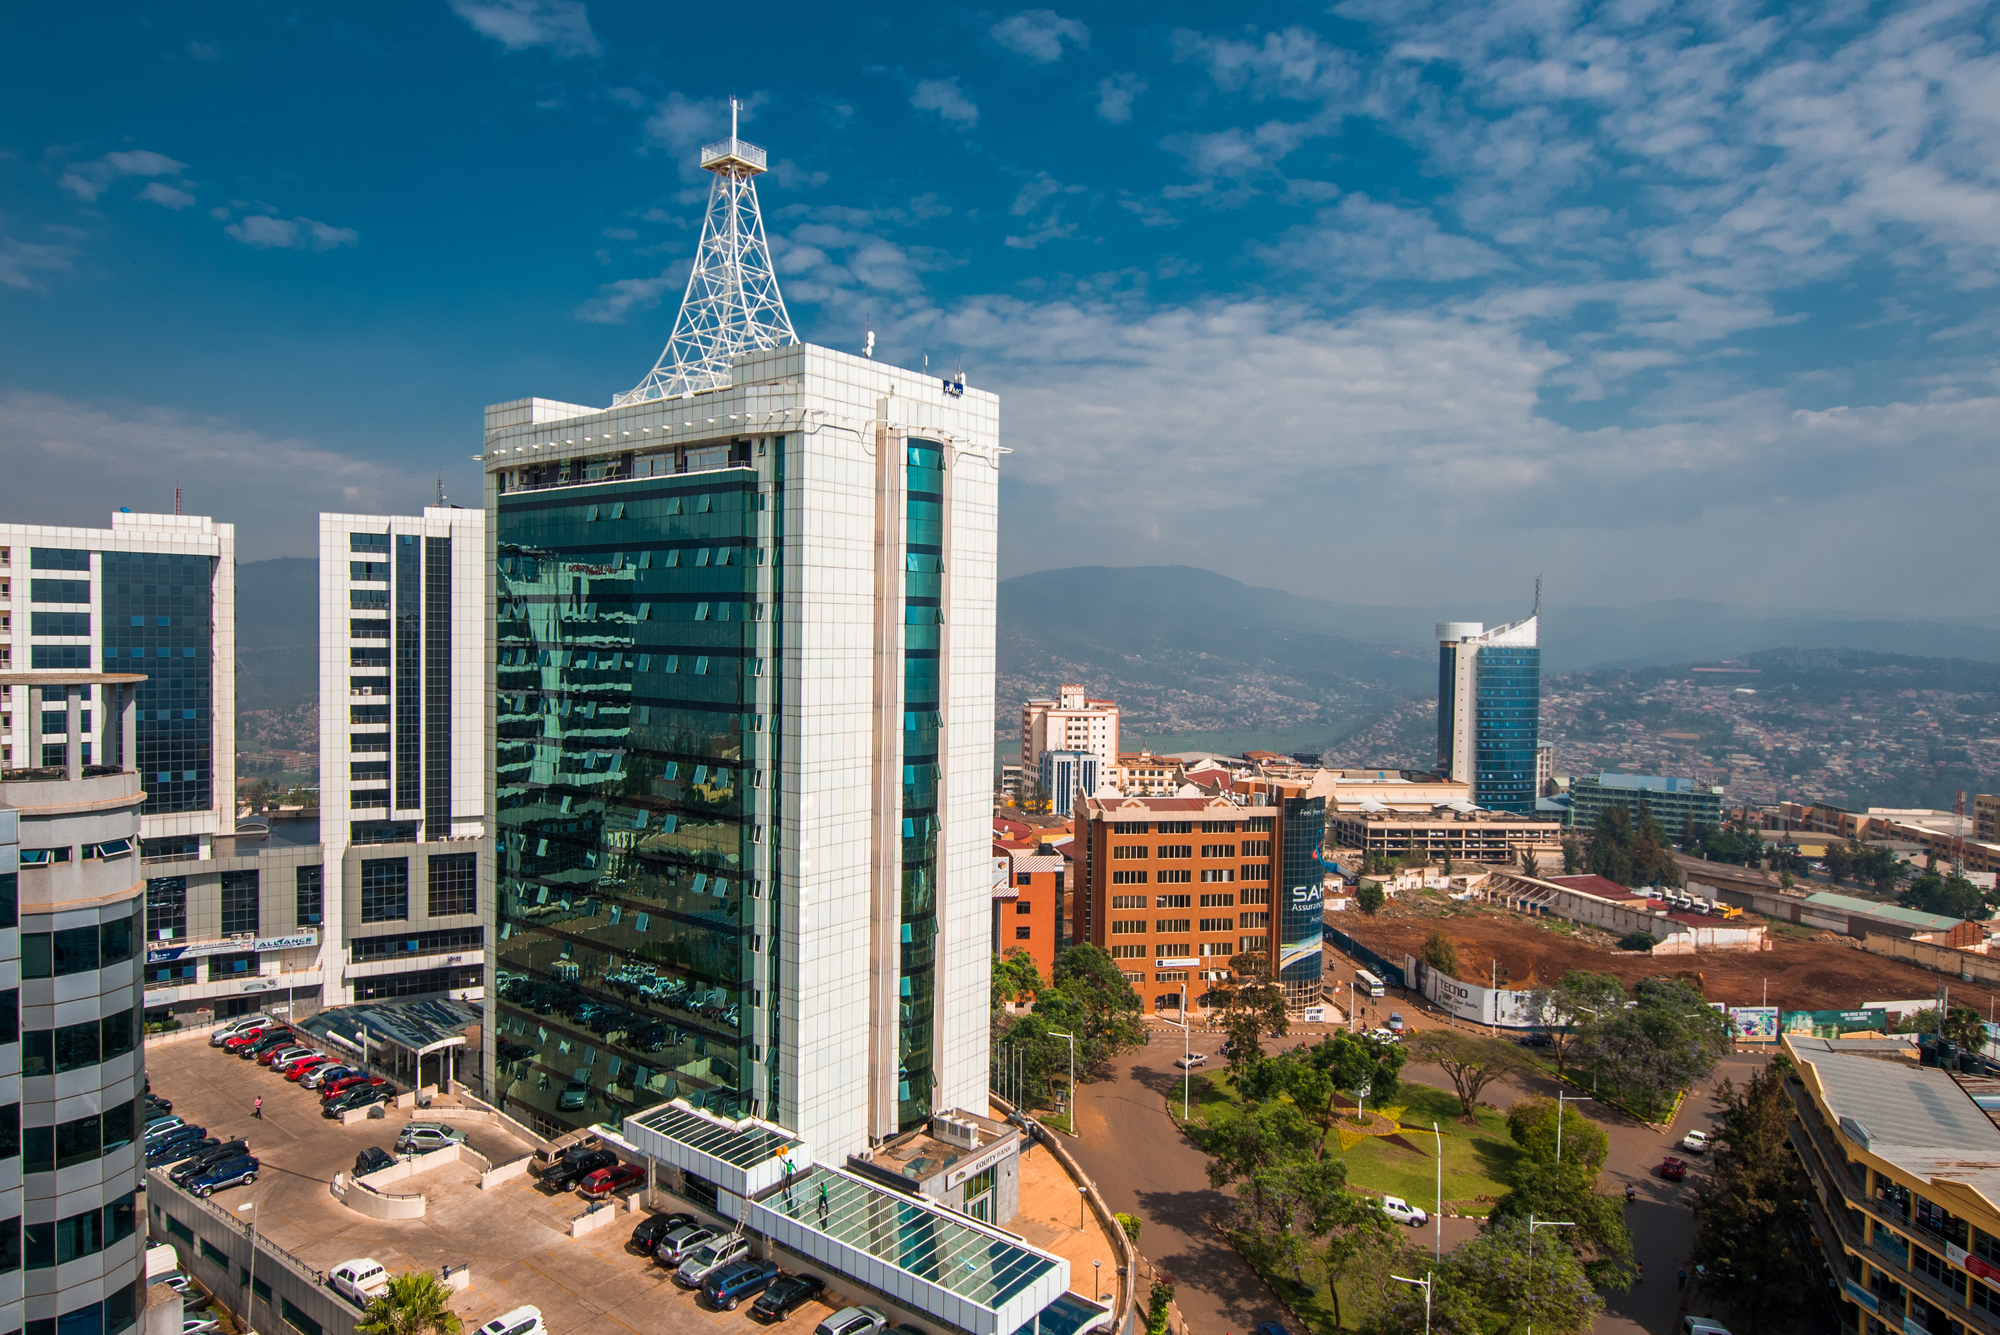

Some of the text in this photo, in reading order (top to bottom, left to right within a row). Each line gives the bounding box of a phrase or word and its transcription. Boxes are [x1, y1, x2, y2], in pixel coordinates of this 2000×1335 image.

[1439, 978, 1468, 999] TECNO
[975, 1145, 1012, 1170] EQUITY BANK
